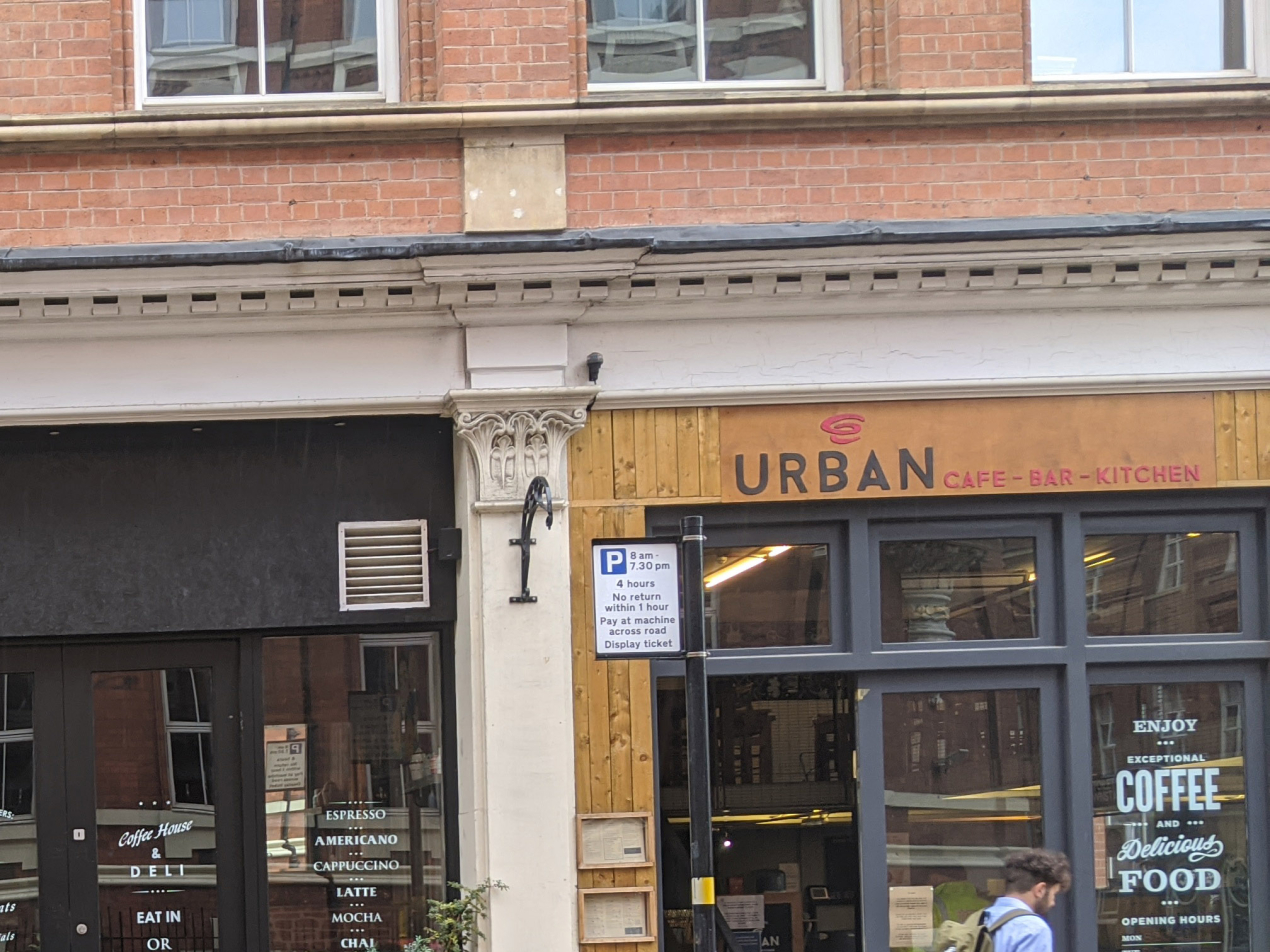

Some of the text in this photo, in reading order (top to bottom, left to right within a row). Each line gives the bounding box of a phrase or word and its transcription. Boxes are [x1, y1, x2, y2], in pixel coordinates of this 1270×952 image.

[734, 447, 934, 495] URBAN
[943, 470, 1007, 489] CAFE
[1029, 467, 1073, 487] BAR
[1095, 464, 1201, 484] KITCHEN
[630, 552, 636, 560] 8
[606, 551, 623, 573] P
[630, 562, 670, 571] 7.30 pm
[616, 580, 655, 588] 4 hours
[612, 593, 627, 601] No
[605, 604, 636, 612] within
[646, 603, 669, 611] hour
[600, 617, 618, 626] Pay
[634, 616, 675, 624] machine
[609, 626, 666, 636] across road
[604, 639, 673, 650] Display ticket
[1132, 718, 1198, 733] ENJOY
[1127, 754, 1206, 764] EXCEPTIONAL
[1115, 767, 1221, 813] COFFEE
[325, 809, 386, 820] ESPRESSO
[1156, 820, 1180, 828] AND
[118, 820, 194, 848] Coffee House
[314, 834, 398, 846] AMERICANO
[152, 848, 161, 859] &
[1116, 834, 1224, 863] Delicious
[313, 860, 400, 872] CAPPUCCINO
[1118, 868, 1221, 893] FOOD
[336, 887, 378, 898] LATTE
[136, 910, 181, 924] EAT IN
[332, 912, 382, 923] MOCHA
[1121, 915, 1221, 926] OPENING HOURS
[146, 938, 172, 950] OR
[340, 938, 375, 948] CHAI
